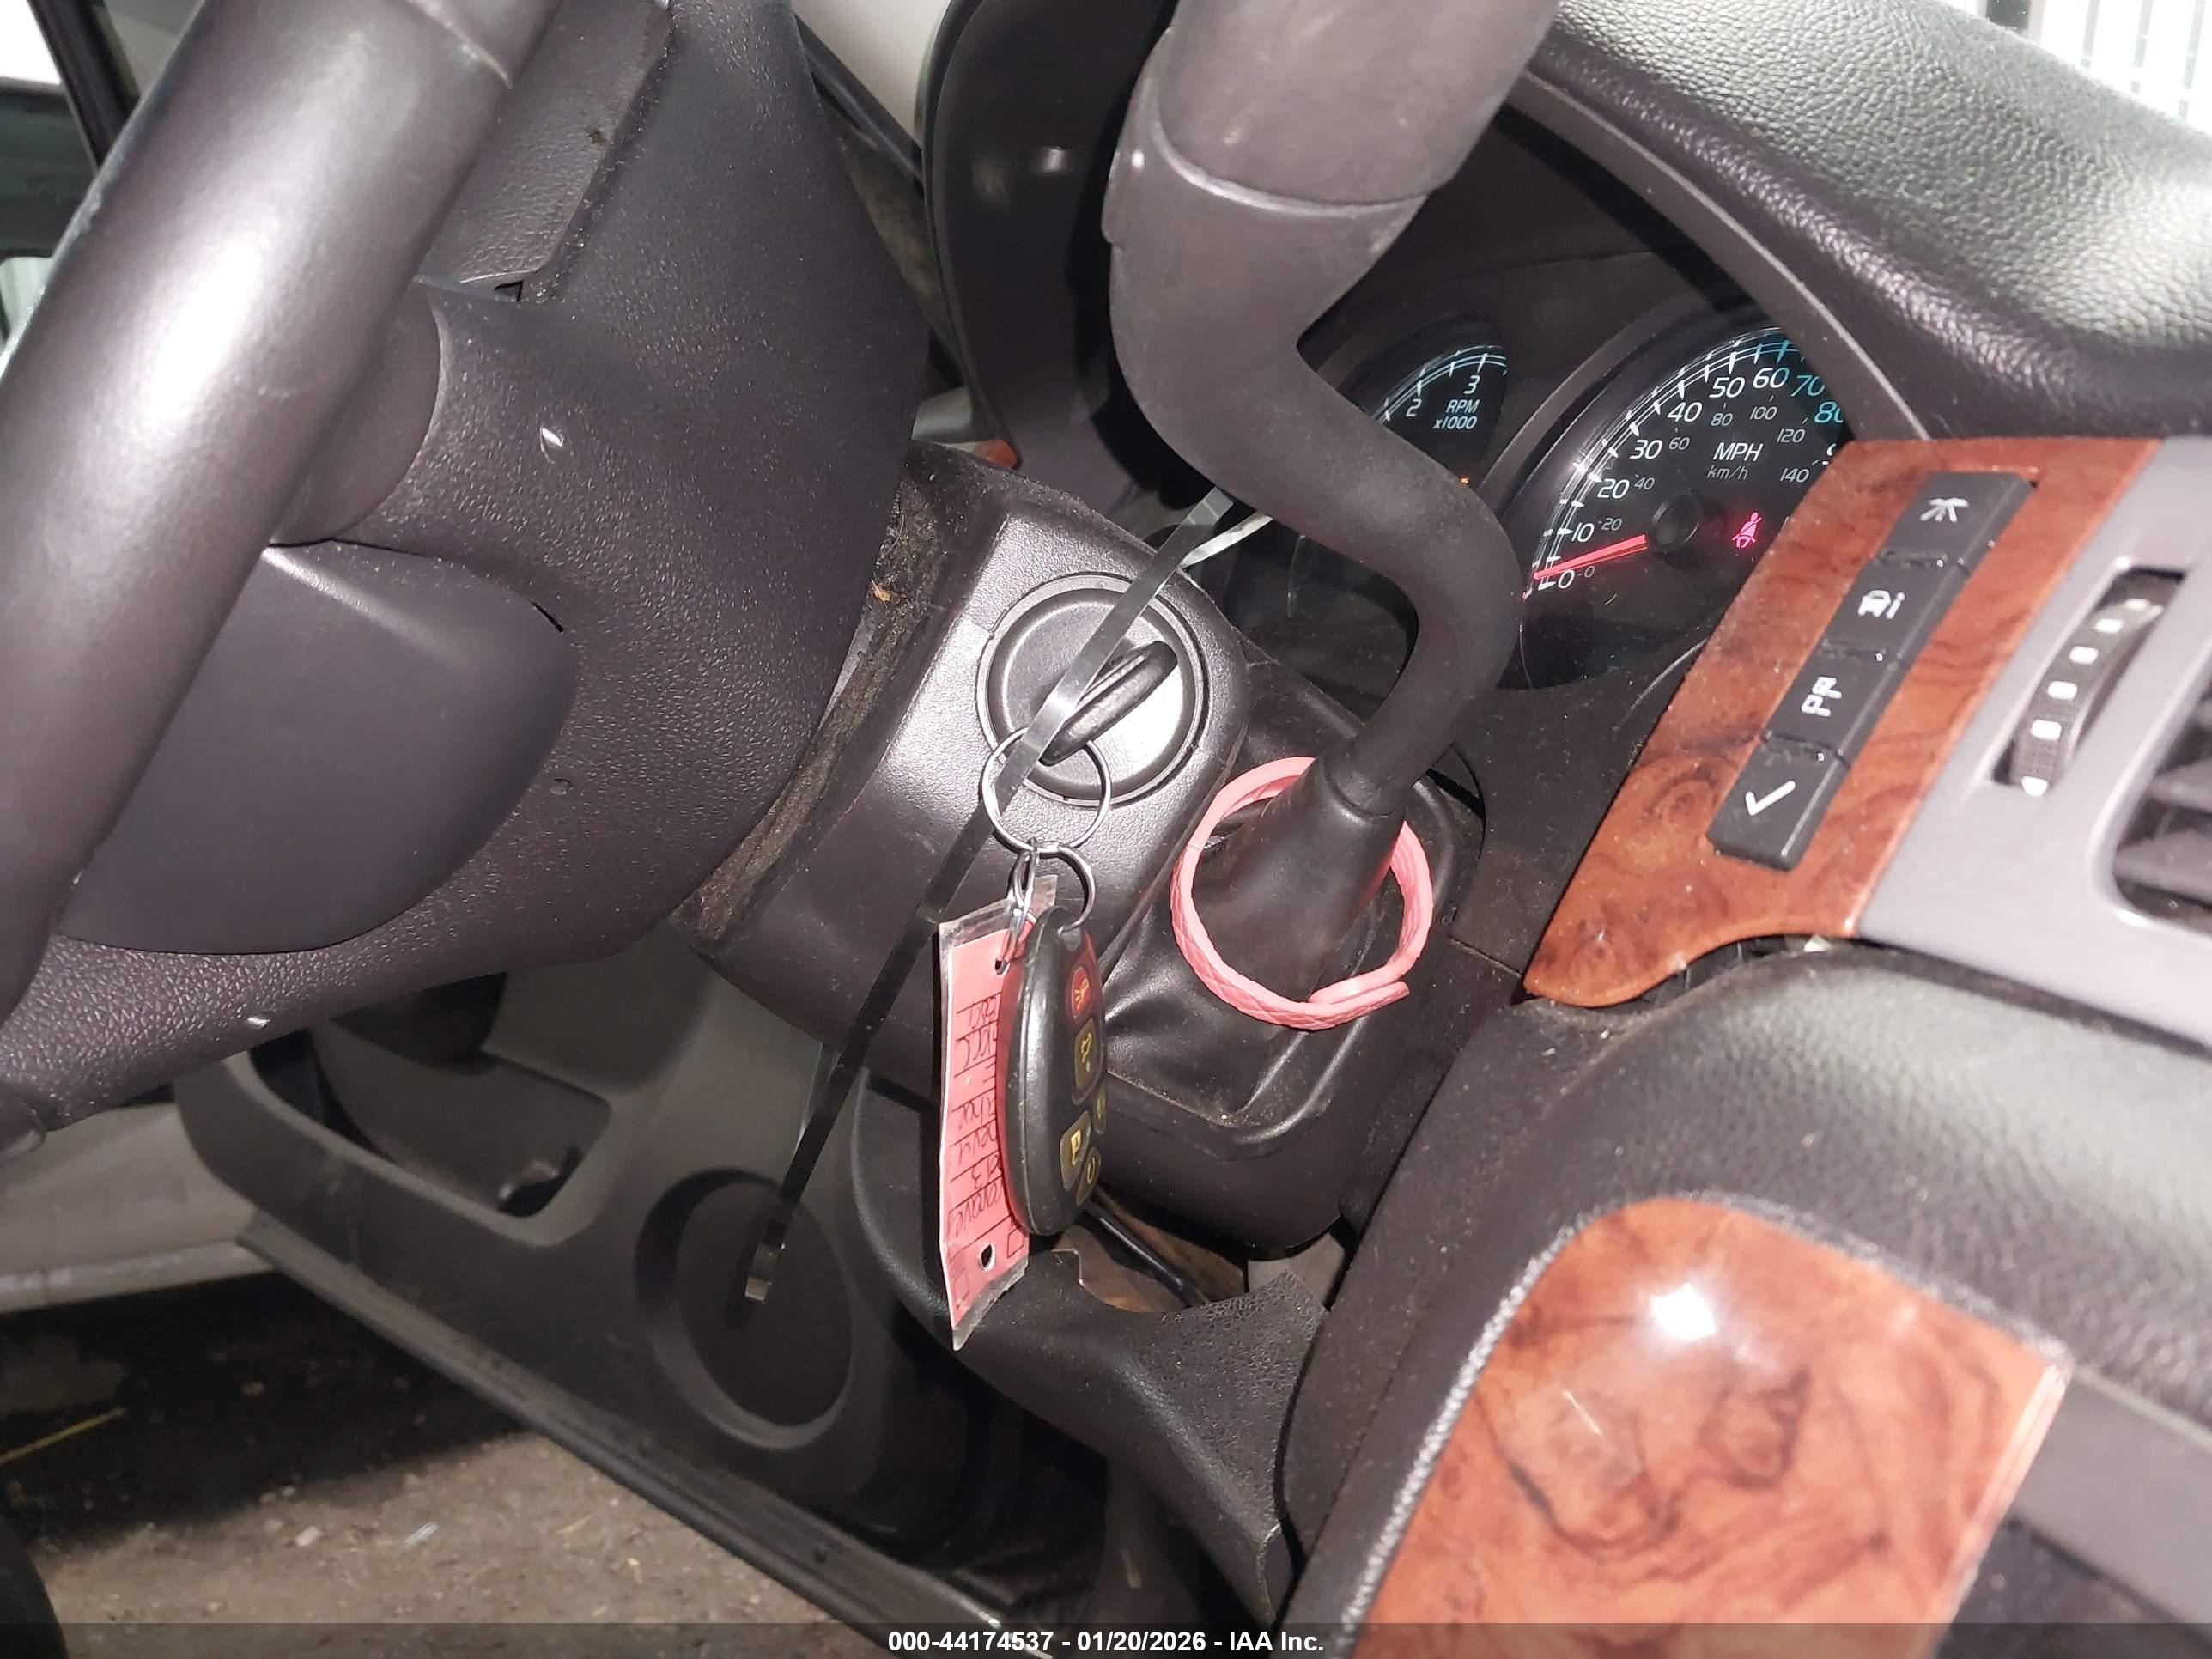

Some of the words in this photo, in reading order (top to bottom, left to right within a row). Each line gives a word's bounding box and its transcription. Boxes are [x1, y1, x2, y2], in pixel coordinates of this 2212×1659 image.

[1463, 374, 1480, 394] 3
[1708, 377, 1746, 398] 50
[1753, 368, 1790, 388] 60
[1790, 374, 1825, 397] 70
[1406, 398, 1422, 417] 2
[1446, 399, 1480, 414] RPM
[1667, 402, 1703, 422] 40
[1749, 406, 1778, 420] 100
[1432, 416, 1478, 430] x1000
[1711, 412, 1734, 427] 80
[1668, 436, 1690, 450] 60
[1777, 428, 1806, 443] 120
[1629, 439, 1663, 459] 30
[1713, 442, 1764, 462] MPH
[1706, 464, 1749, 481] km/h
[1779, 468, 1809, 483] 140
[1597, 478, 1630, 499] 20
[1634, 477, 1656, 490] 40
[1571, 522, 1594, 543] 10
[1601, 518, 1622, 531] 20
[1558, 569, 1575, 589] 0
